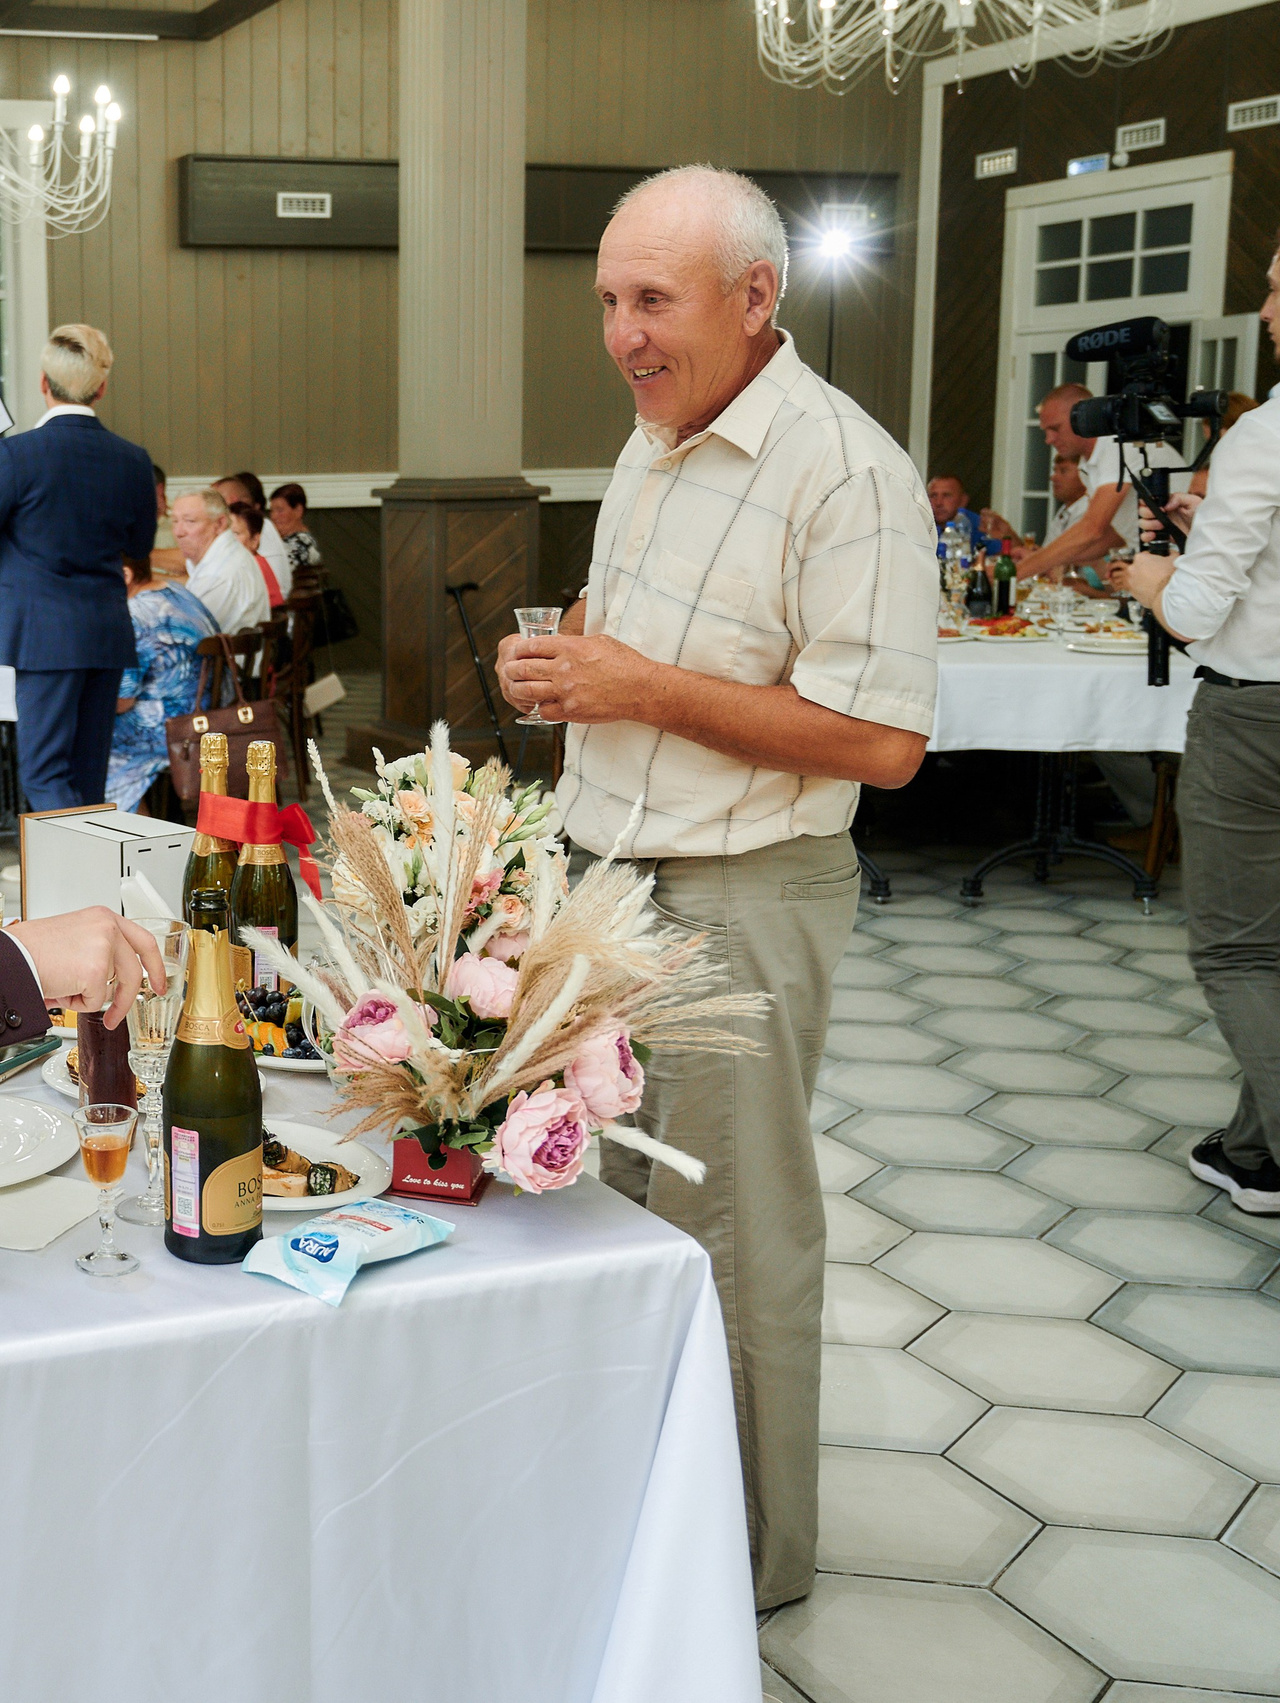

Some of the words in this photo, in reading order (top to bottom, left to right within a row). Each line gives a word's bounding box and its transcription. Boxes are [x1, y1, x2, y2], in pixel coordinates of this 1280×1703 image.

[1077, 327, 1131, 352] RØDE
[184, 1021, 210, 1032] BOSCA
[402, 1174, 422, 1184] Love
[423, 1178, 431, 1186] to
[433, 1178, 449, 1188] kiss
[450, 1182, 465, 1190] you
[235, 1197, 255, 1208] ANNA
[298, 1237, 335, 1257] AURA
